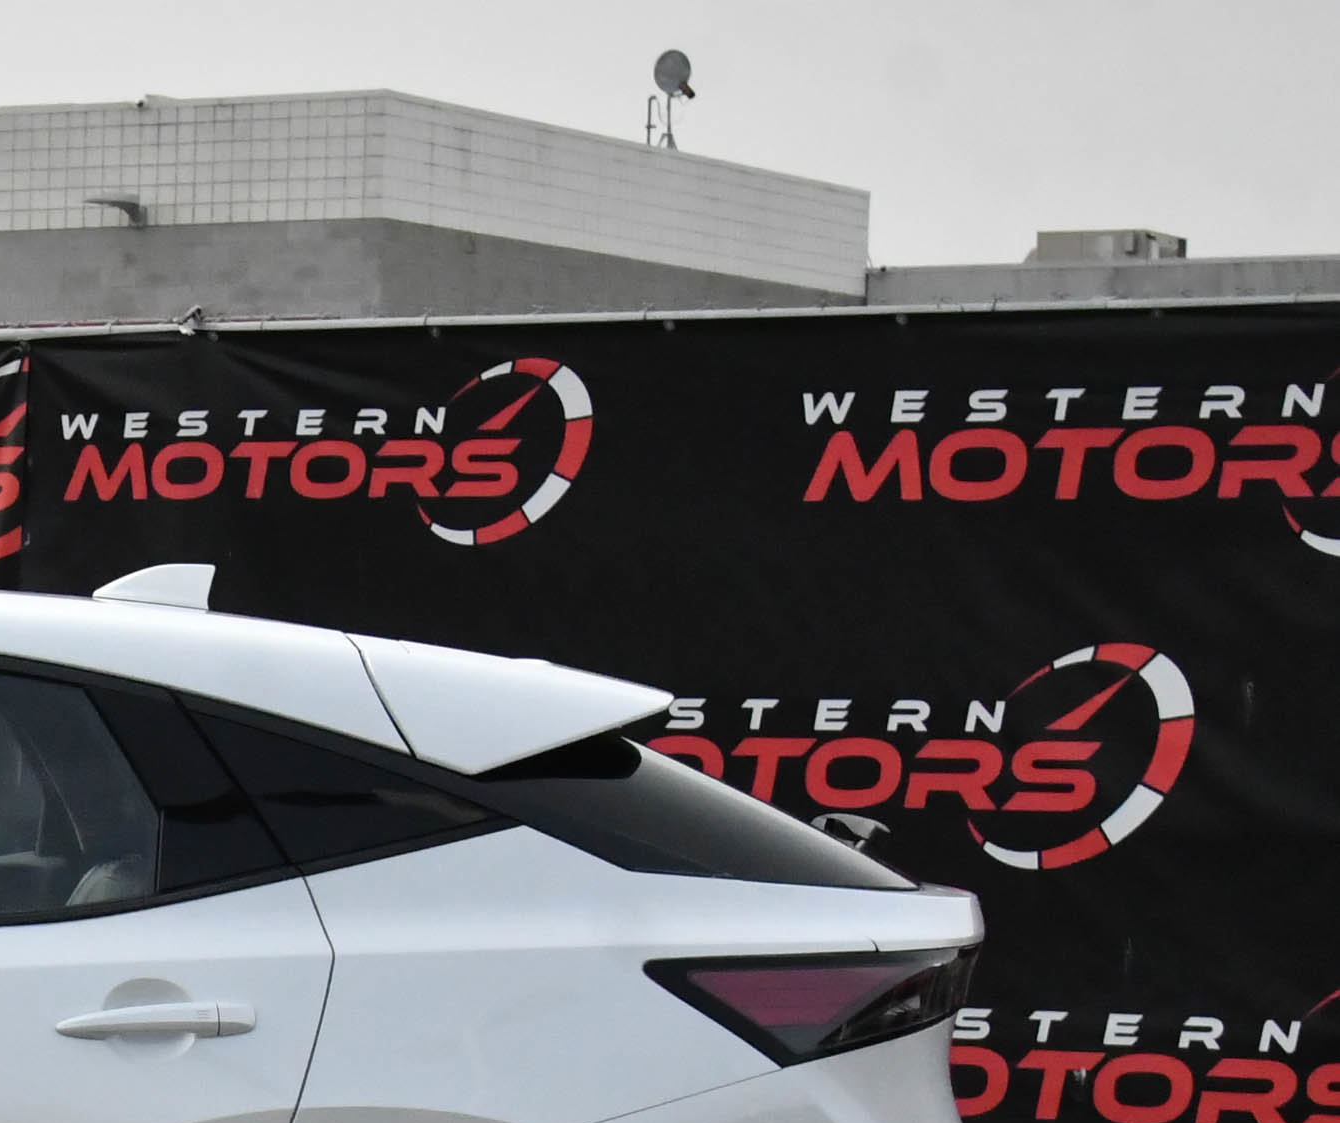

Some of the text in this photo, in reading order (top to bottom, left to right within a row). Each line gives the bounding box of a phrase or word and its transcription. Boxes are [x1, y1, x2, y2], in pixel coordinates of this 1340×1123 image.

[61, 407, 446, 440] WESTERN
[802, 384, 1325, 424] WESTERN
[64, 438, 521, 501] MOTORS
[805, 425, 1340, 501] MOTOR
[665, 698, 1006, 732] STERN
[953, 1007, 1302, 1054] STERN
